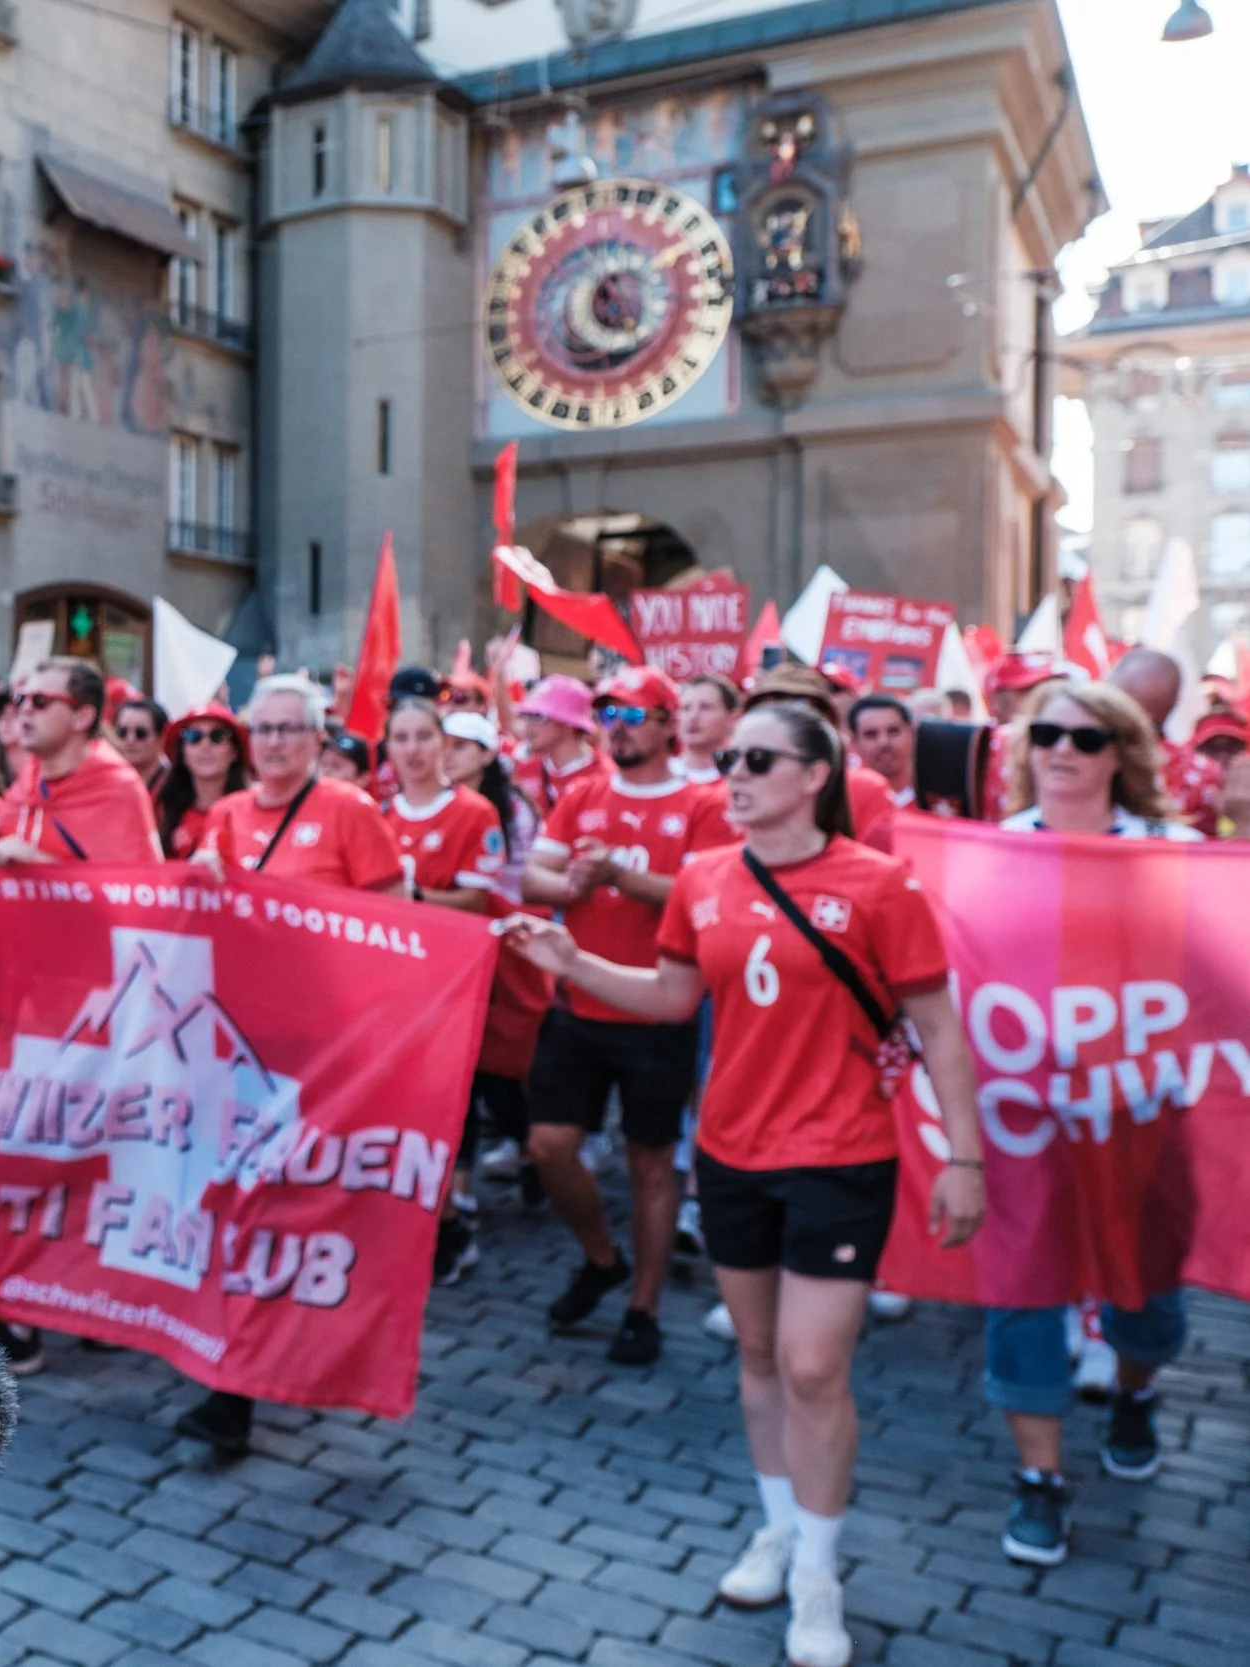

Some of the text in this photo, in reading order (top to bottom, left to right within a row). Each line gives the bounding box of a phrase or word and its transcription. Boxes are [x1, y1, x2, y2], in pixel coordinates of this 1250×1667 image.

[101, 882, 253, 919] WOMEN'S
[263, 898, 428, 960] FOOTBALL
[744, 934, 780, 1008] 6
[946, 967, 1190, 1074] OPP
